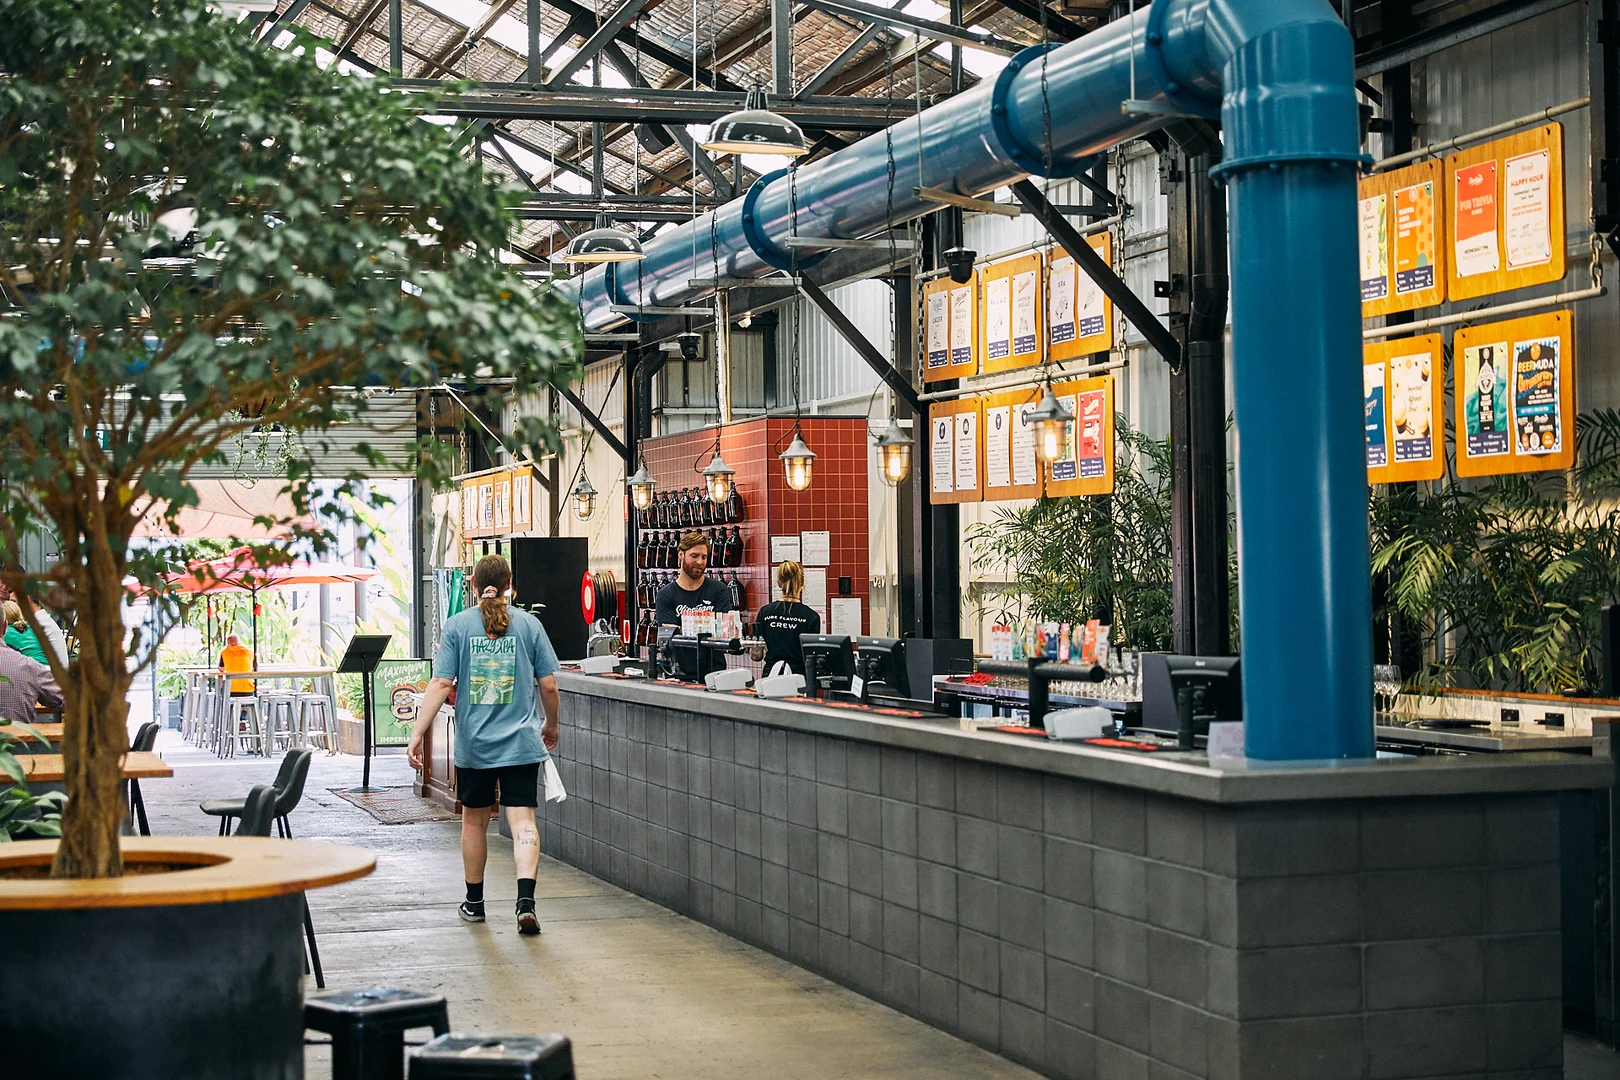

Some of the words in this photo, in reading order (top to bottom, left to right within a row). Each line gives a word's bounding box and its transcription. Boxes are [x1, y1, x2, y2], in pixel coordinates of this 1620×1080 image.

[1511, 178, 1528, 187] HAPPY
[1529, 173, 1543, 183] HOUR
[1472, 194, 1493, 208] TRIVIA
[1518, 358, 1554, 373] BEERMUDA
[770, 621, 798, 630] CREW
[779, 615, 807, 623] FLAVOUR
[472, 638, 496, 654] HAZY
[495, 637, 515, 654] XPA
[376, 661, 427, 681] MAXIMUM
[384, 673, 422, 689] G-FORCE
